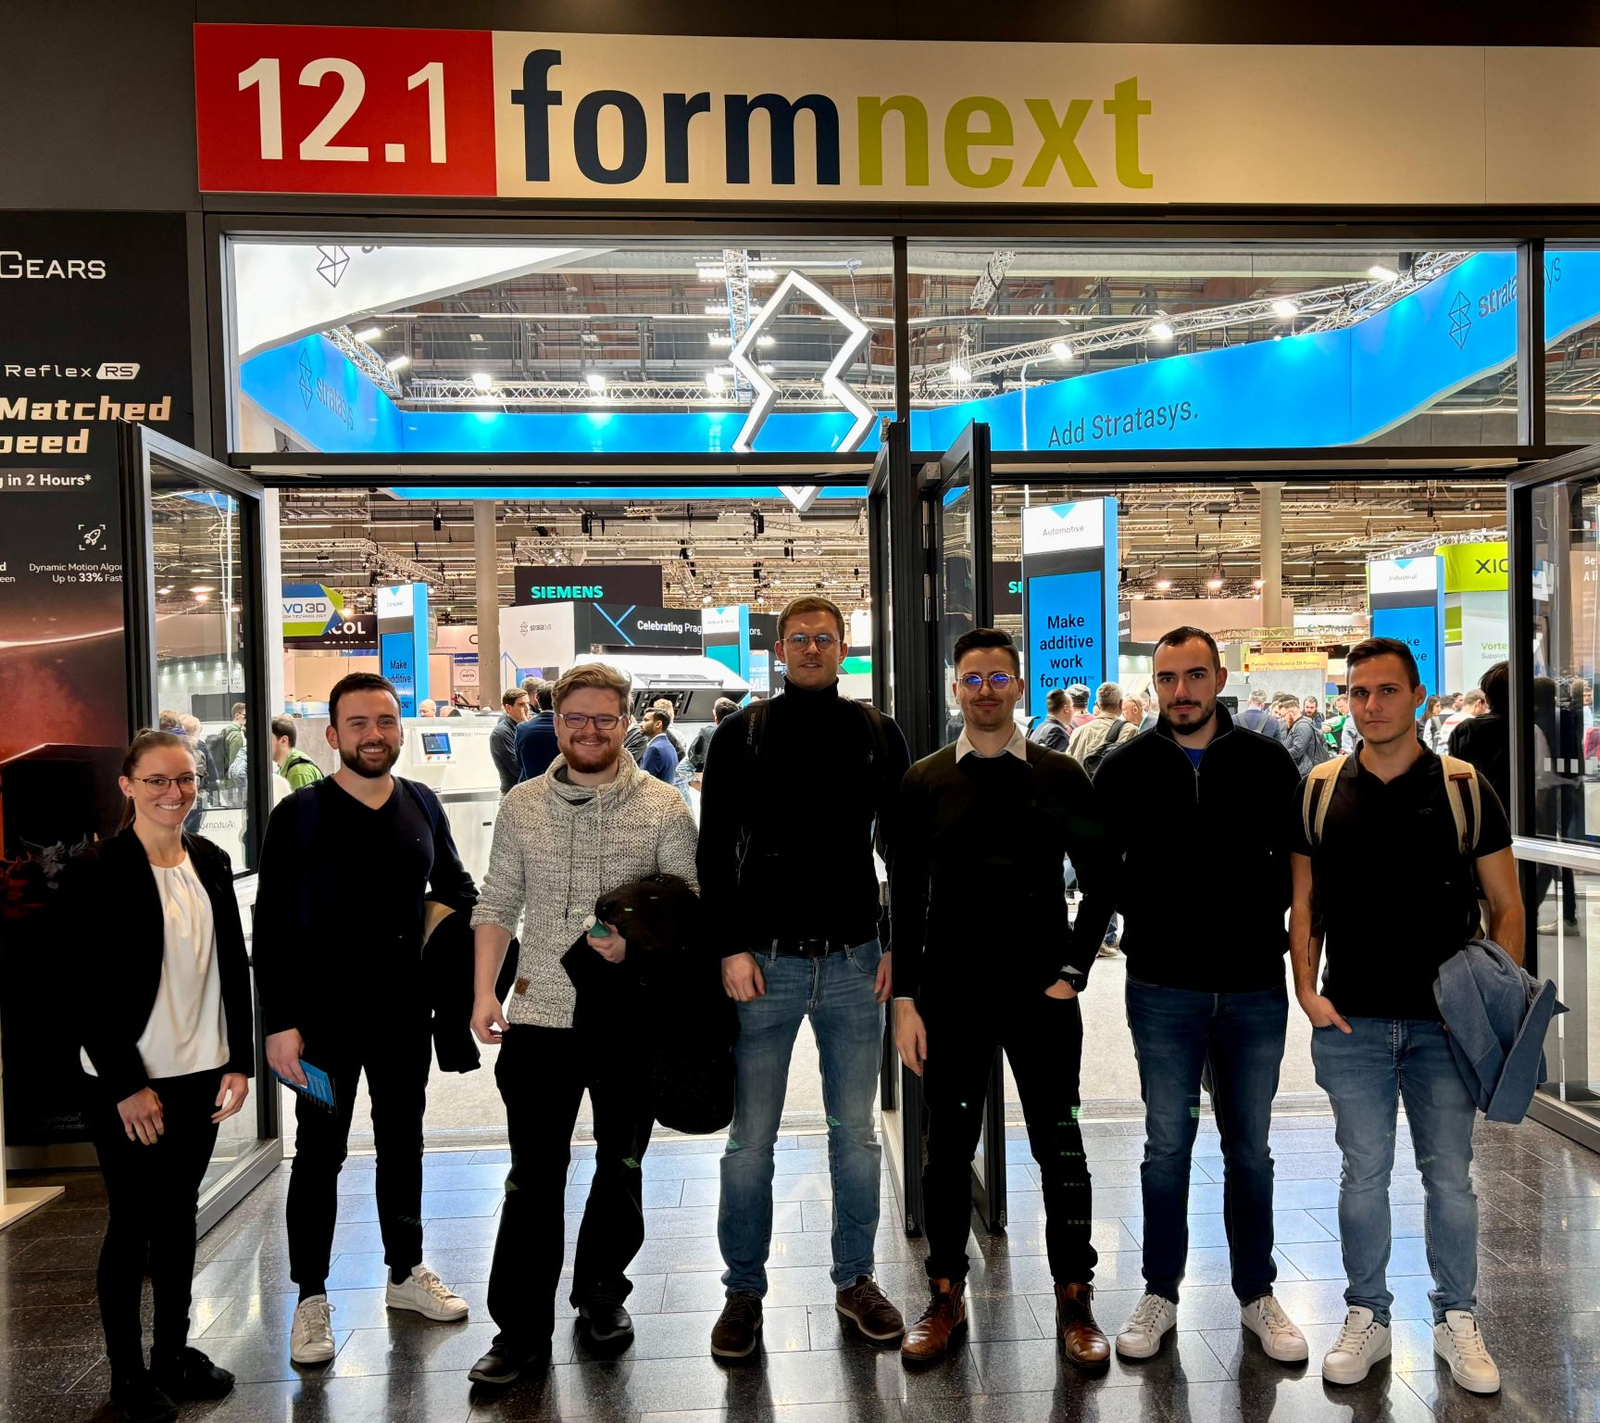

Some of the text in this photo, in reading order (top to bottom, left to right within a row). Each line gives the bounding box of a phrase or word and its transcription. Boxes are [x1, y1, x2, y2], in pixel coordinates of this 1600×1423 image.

[238, 49, 1153, 189] 12.1 formnext
[4, 364, 134, 378] Reflex RS
[0, 395, 172, 421] Matched
[1048, 401, 1199, 448] Add Stratasys.
[8, 474, 21, 486] in
[26, 474, 35, 486] 2
[1043, 525, 1084, 536] Automotive
[29, 563, 66, 573] Dynamic
[68, 563, 98, 572] Motion
[53, 574, 65, 584] Up
[79, 573, 103, 582] 33%
[531, 585, 604, 599] SIEMENS
[305, 603, 326, 614] 3D
[328, 621, 366, 635] COL
[637, 620, 682, 634] Celebrating
[1048, 614, 1085, 629] Make
[1040, 635, 1094, 650] additive
[390, 660, 407, 670] Make
[1050, 654, 1083, 669] work
[1040, 674, 1059, 688] for
